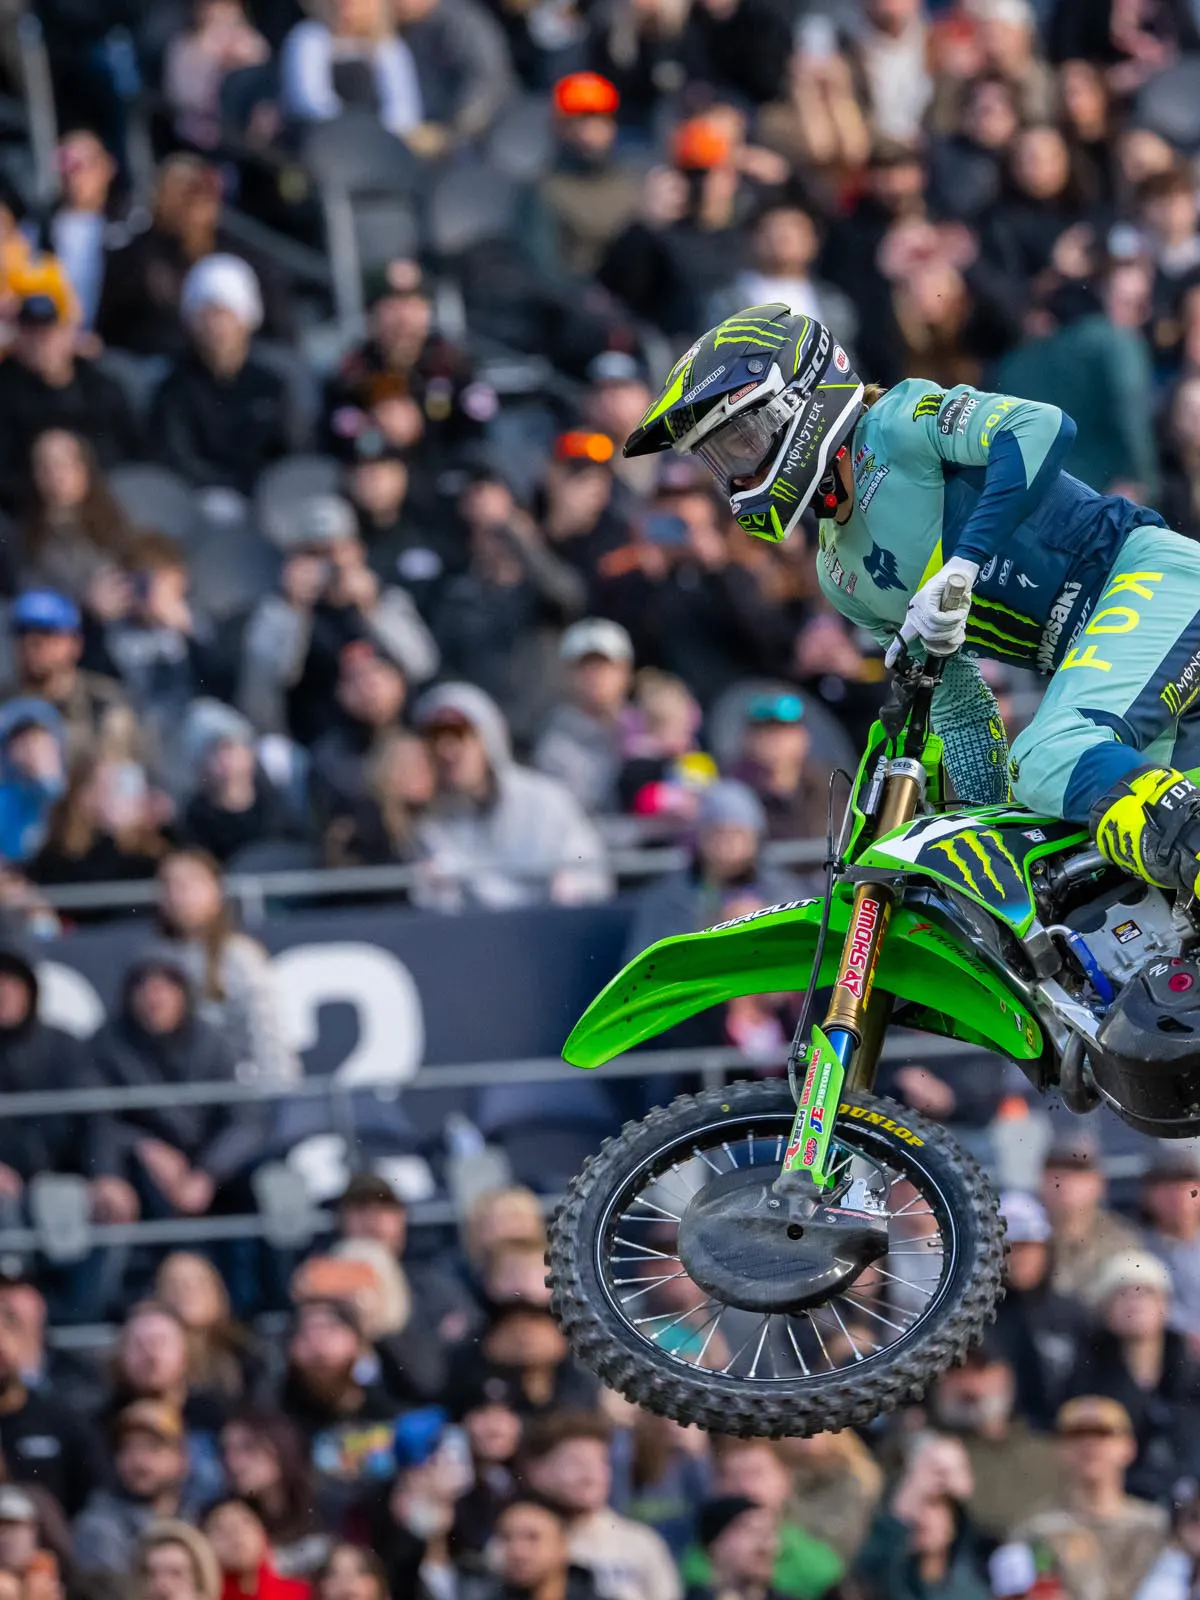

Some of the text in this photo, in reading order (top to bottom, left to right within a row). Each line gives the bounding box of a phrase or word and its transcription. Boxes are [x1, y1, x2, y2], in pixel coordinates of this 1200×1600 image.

[800, 417, 826, 468] ENERGY
[981, 400, 1017, 447] FOX
[859, 465, 889, 512] Kawasaki
[1059, 571, 1165, 673] FOX
[1160, 779, 1197, 811] FOX
[711, 898, 819, 932] CIRCUIT
[847, 898, 880, 973] SHOWA
[801, 1049, 821, 1105] BRAKING
[815, 1063, 831, 1106] PISTONS
[810, 1107, 824, 1134] JE
[839, 1103, 925, 1147] DUNLOP
[803, 1138, 818, 1166] GUTS
